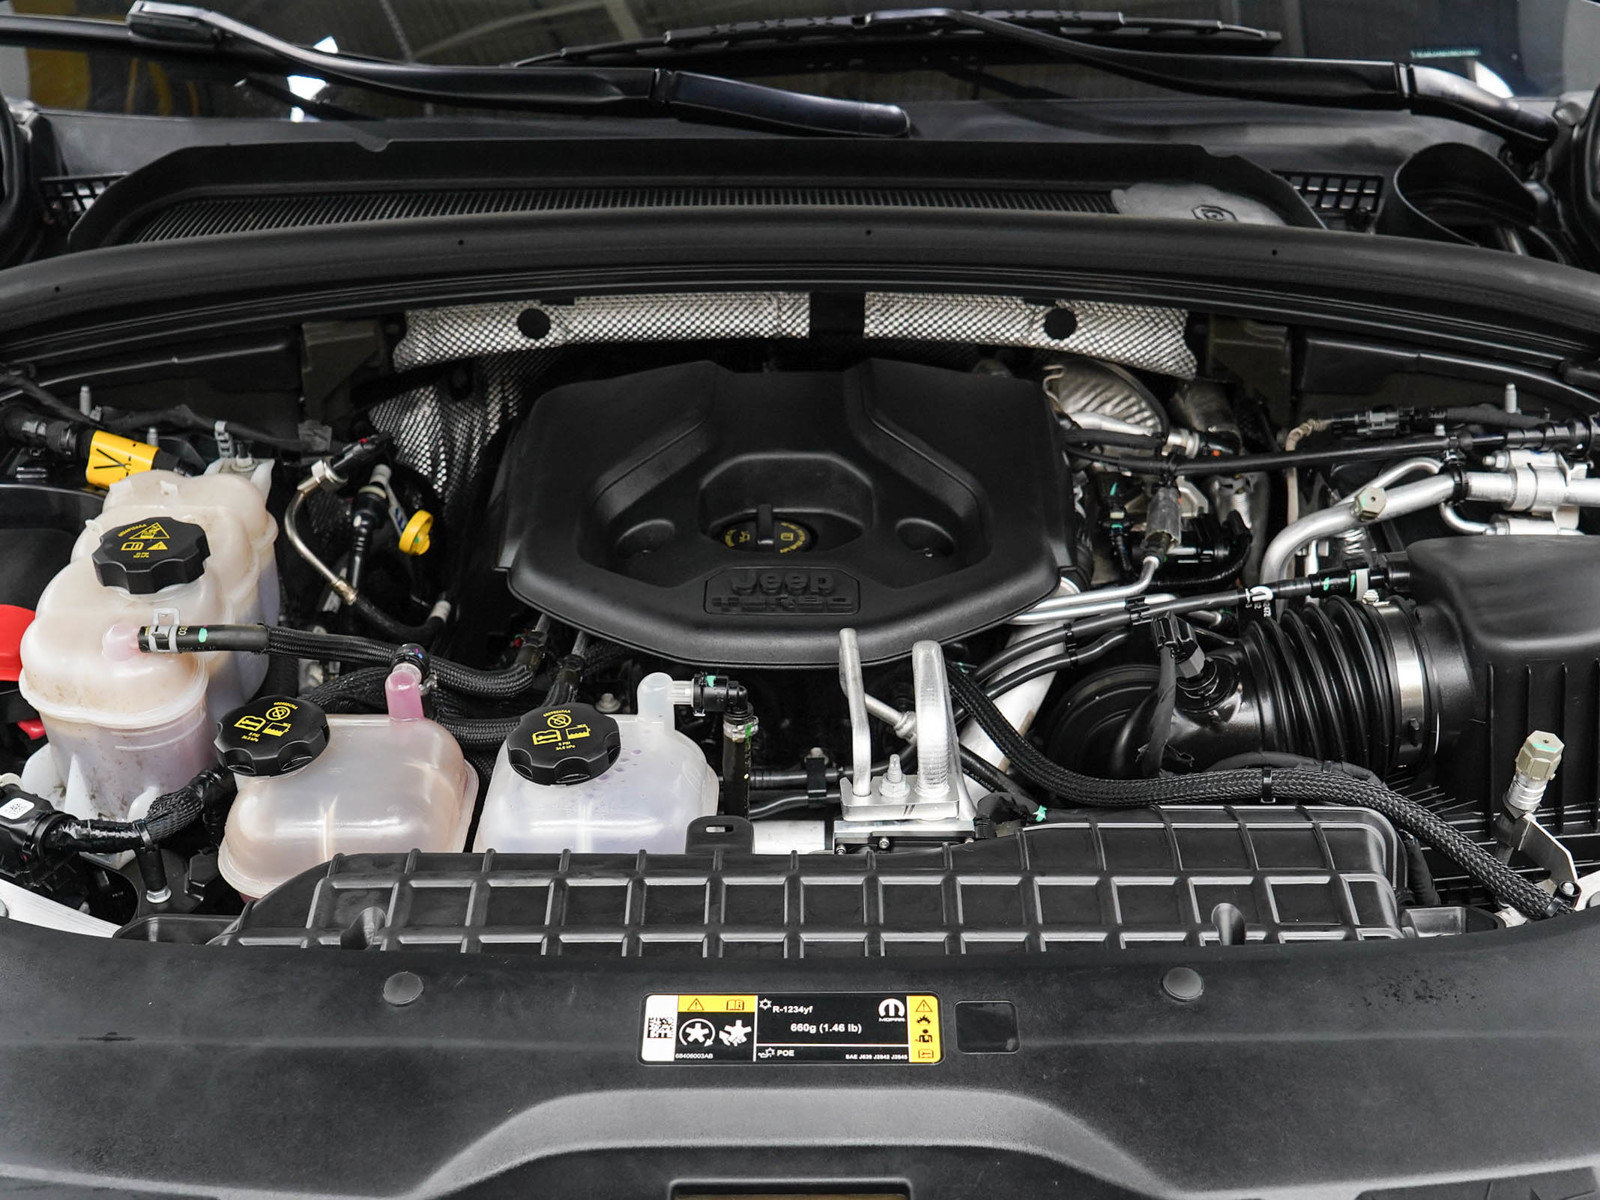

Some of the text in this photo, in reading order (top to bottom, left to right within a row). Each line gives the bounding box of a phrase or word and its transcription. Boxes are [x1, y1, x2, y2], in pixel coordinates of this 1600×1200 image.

[731, 570, 834, 597] Jeep
[772, 1005, 813, 1014] R-1234yf
[790, 1023, 862, 1034] 660g (1.46 lb)
[776, 1049, 795, 1057] POE
